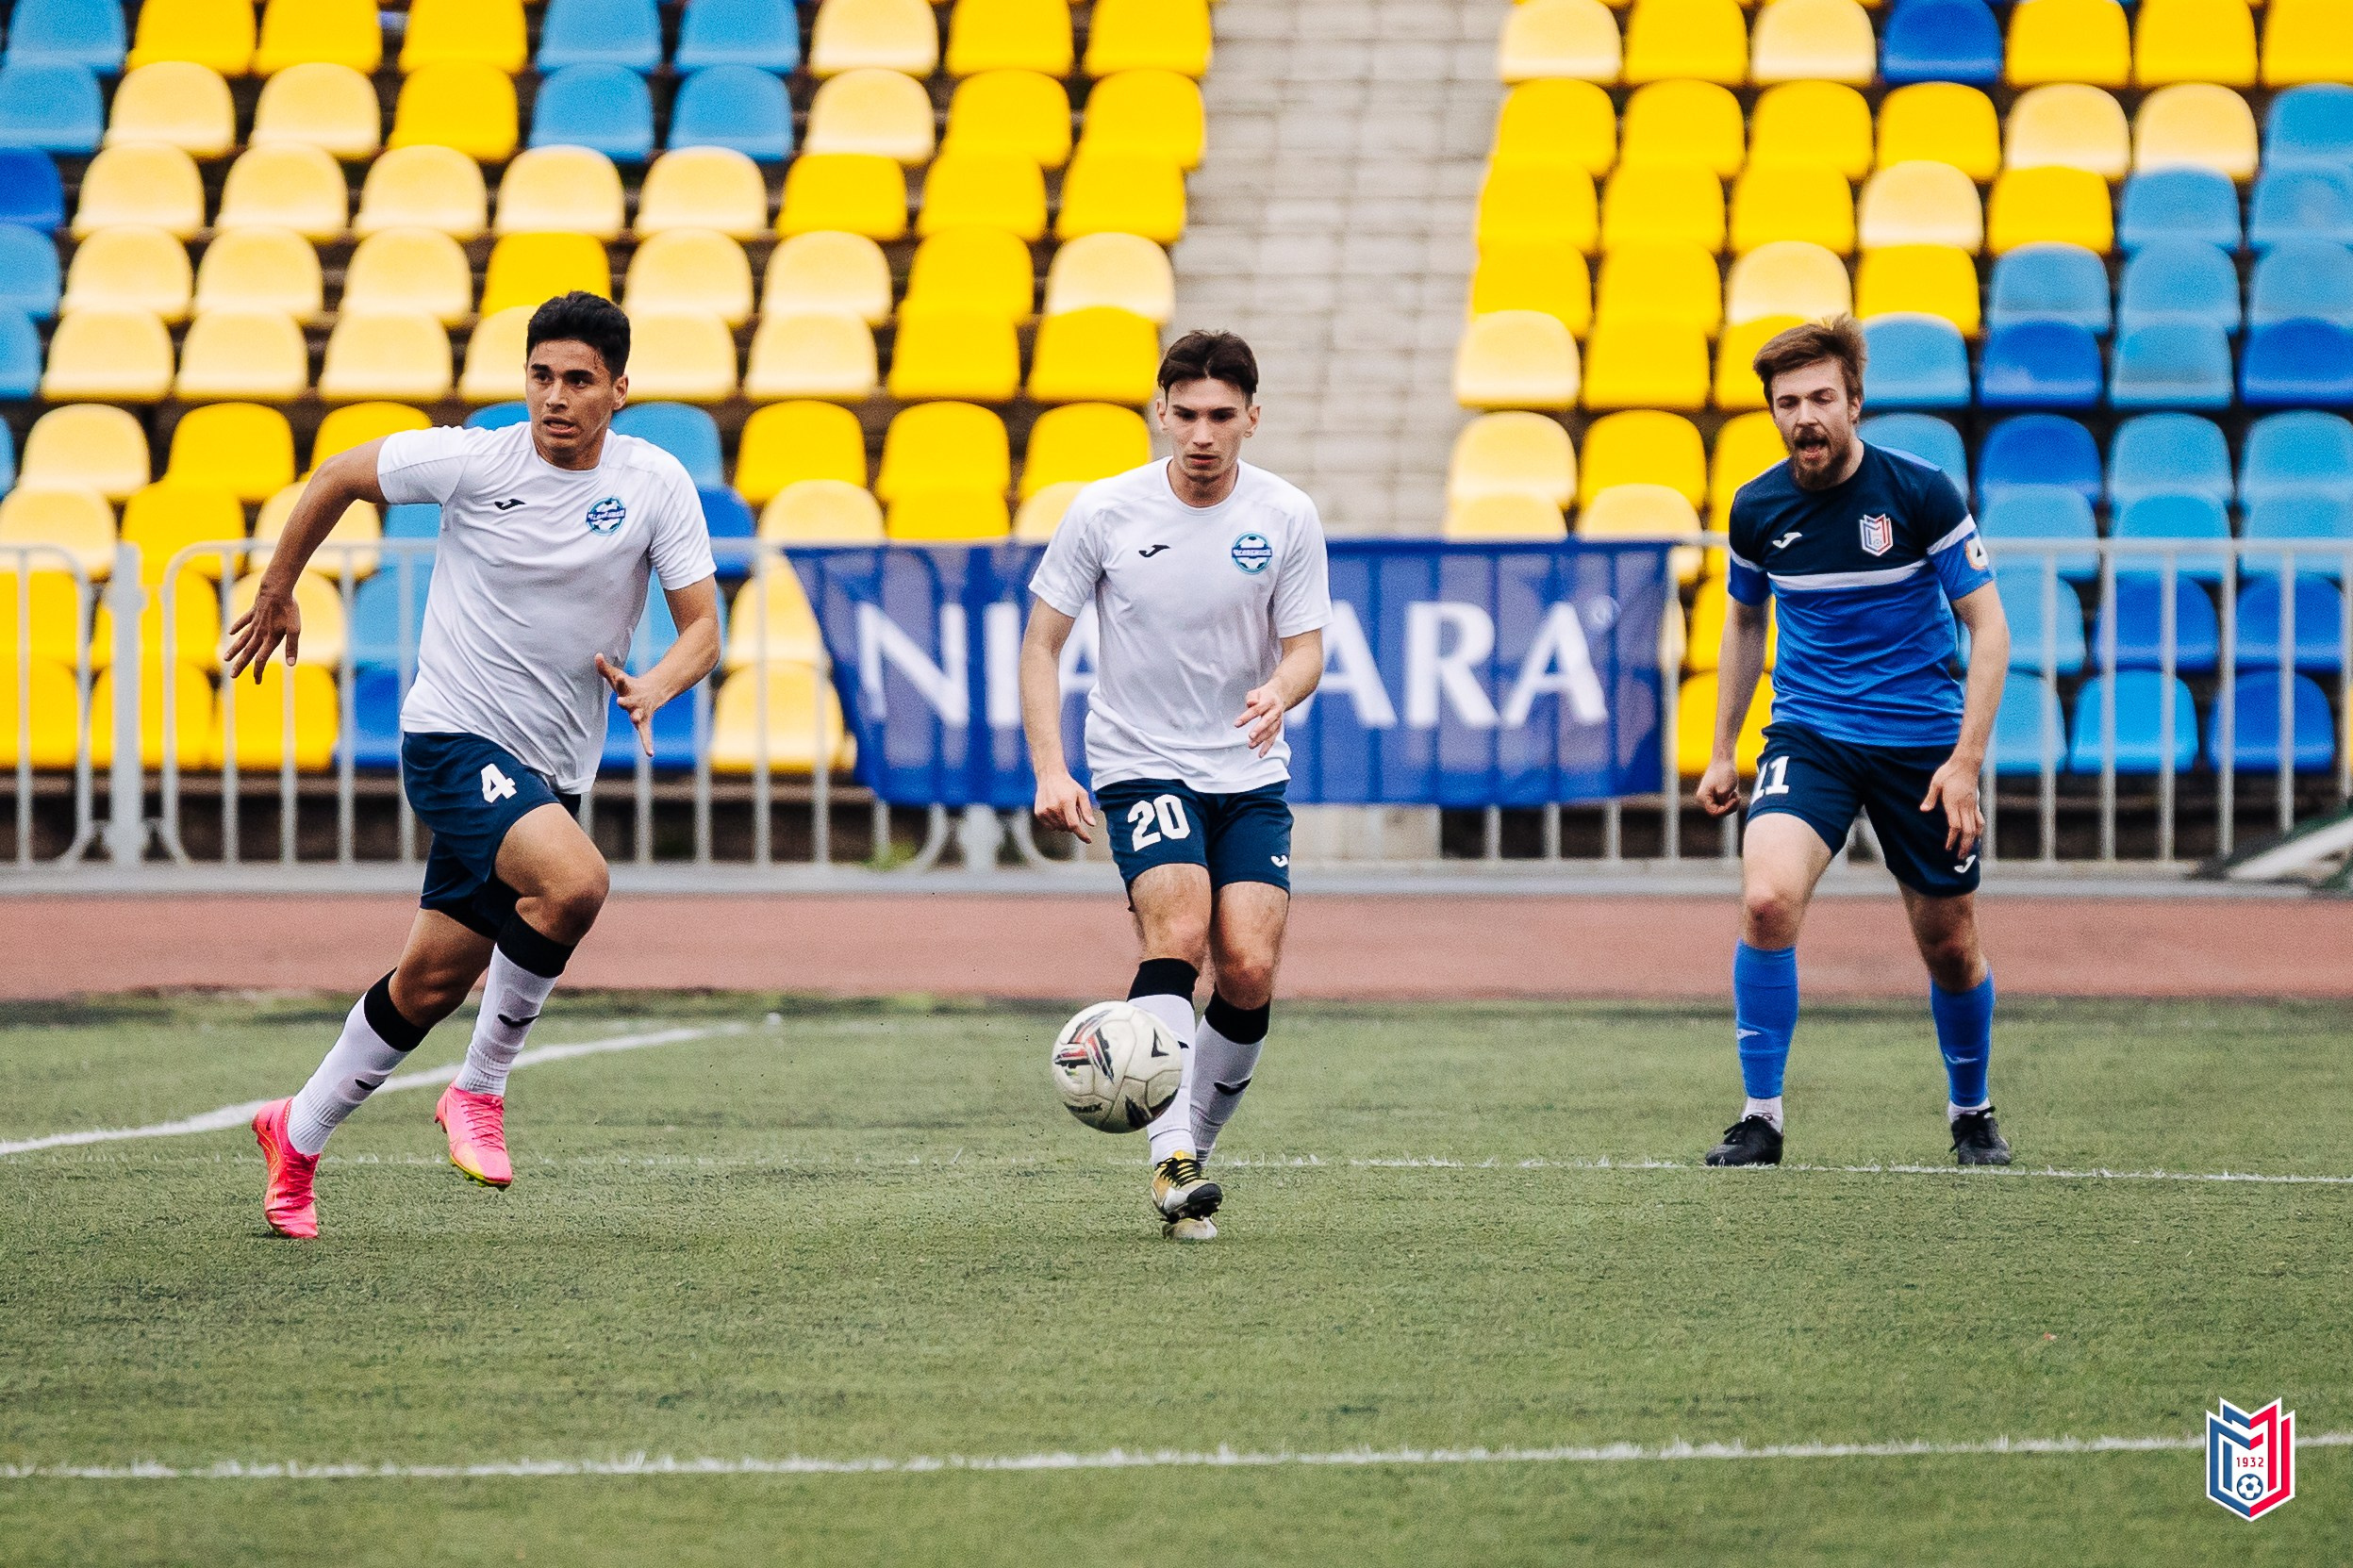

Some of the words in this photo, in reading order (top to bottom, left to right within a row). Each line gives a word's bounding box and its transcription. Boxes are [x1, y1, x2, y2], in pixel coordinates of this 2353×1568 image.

[857, 601, 1607, 728] NIAARA
[480, 763, 518, 803] 4
[1750, 756, 1790, 804] 11
[1127, 793, 1191, 852] 20
